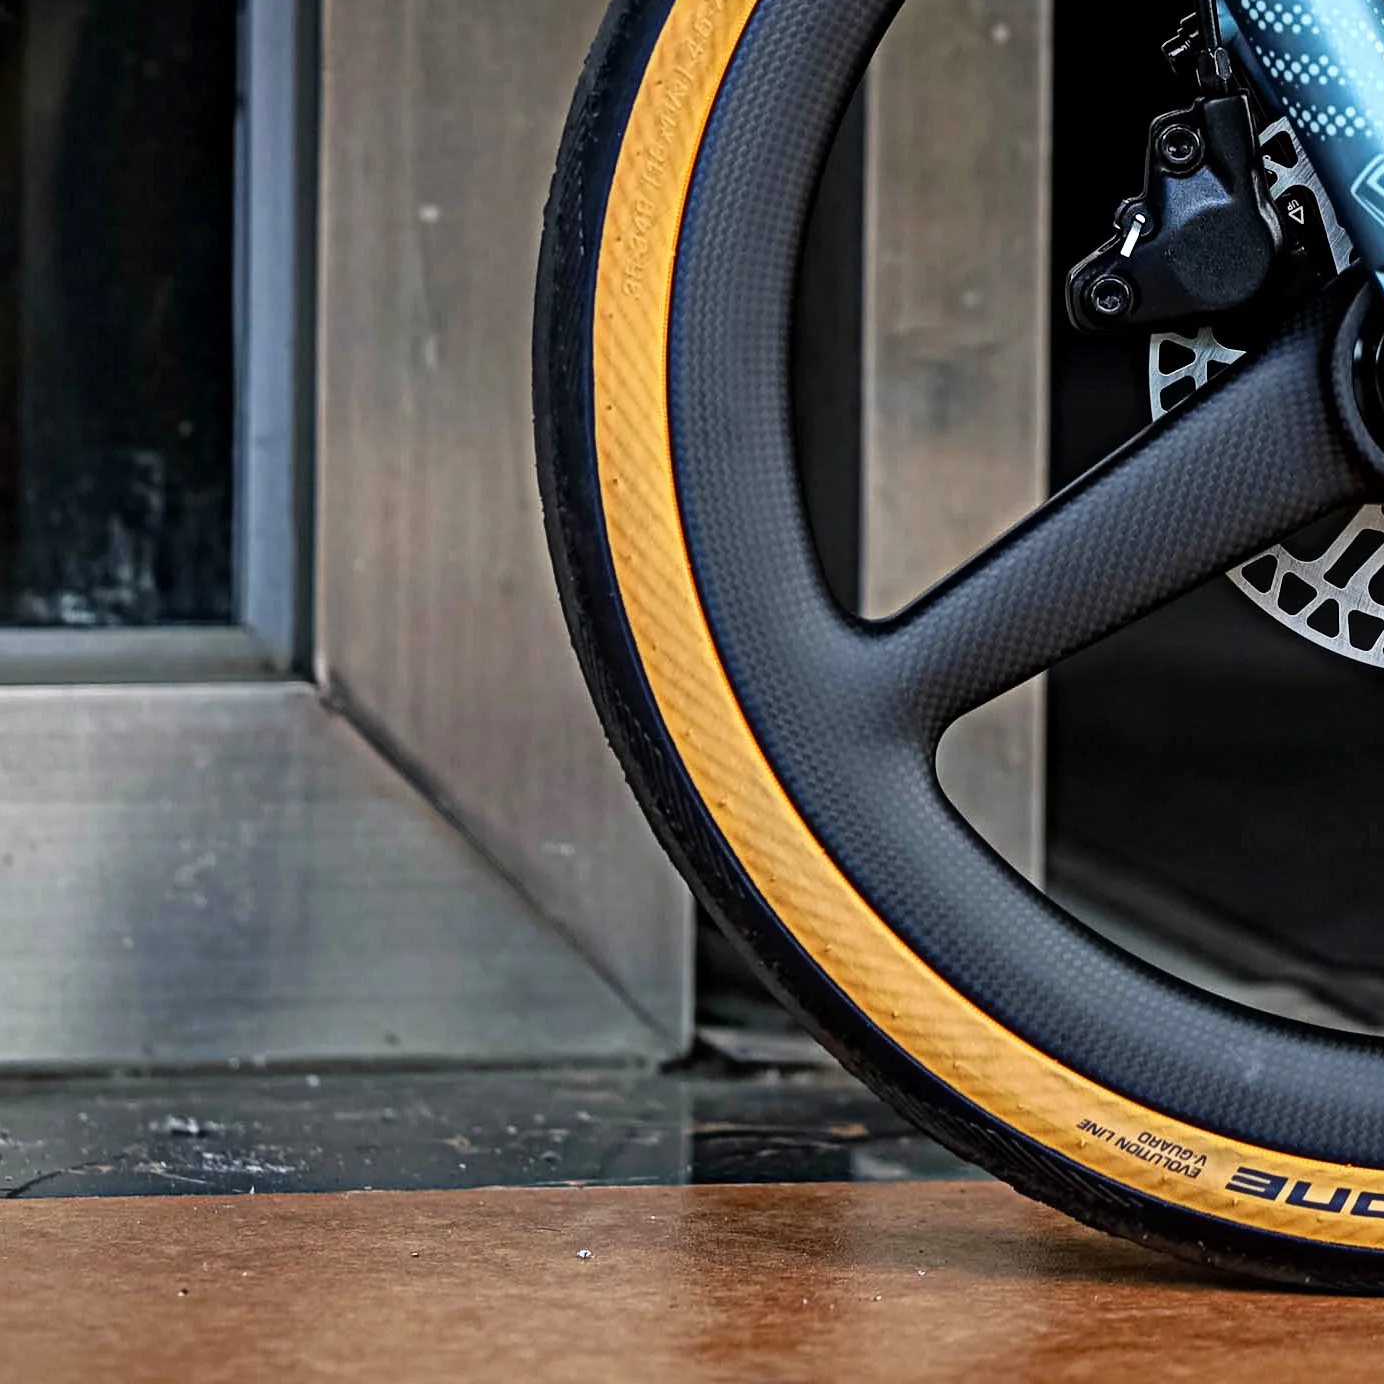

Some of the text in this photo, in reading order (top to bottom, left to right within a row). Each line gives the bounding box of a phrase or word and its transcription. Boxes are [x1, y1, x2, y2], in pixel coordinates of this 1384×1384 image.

[1287, 199, 1300, 212] UP
[1077, 1119, 1202, 1179] EVOLUTION LINE
[1138, 1131, 1208, 1167] V-GUARD
